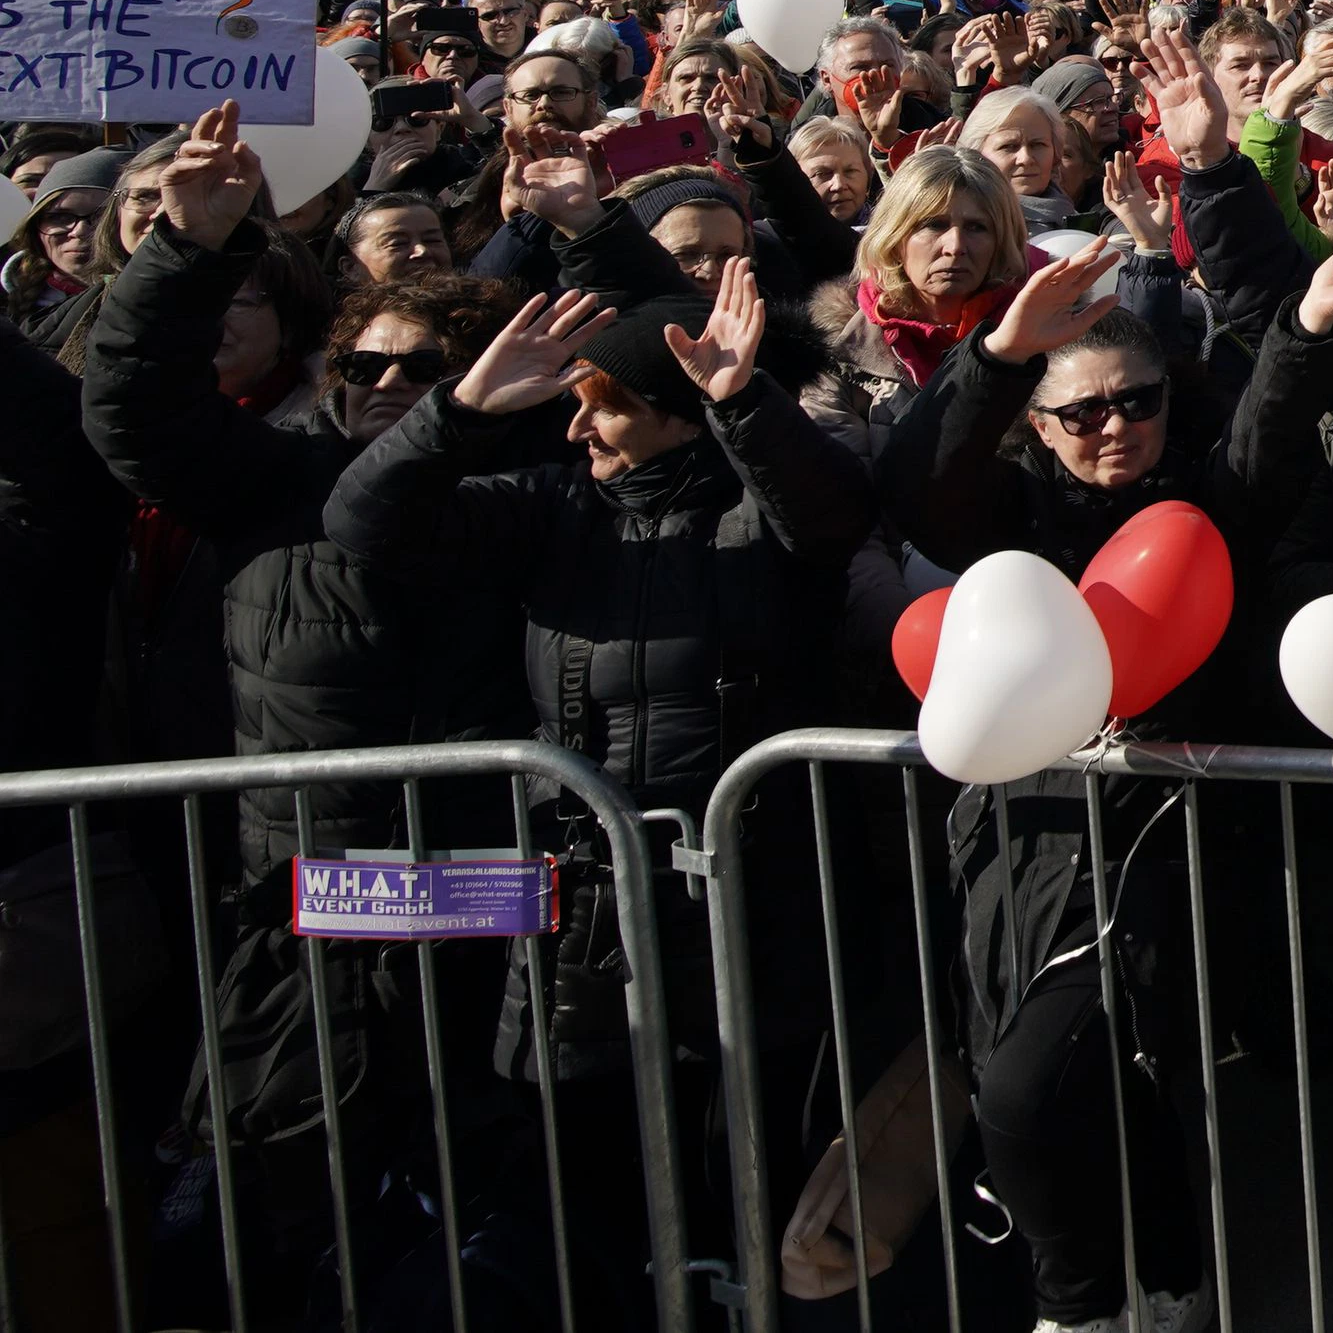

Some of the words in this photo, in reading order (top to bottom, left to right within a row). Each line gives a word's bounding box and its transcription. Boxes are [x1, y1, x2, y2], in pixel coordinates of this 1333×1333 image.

[95, 48, 296, 92] BITCOIN
[304, 868, 429, 899] W.H.A.T.
[442, 867, 536, 877] VERANSTALTUNGSTECHNIK
[302, 899, 365, 914] EVENT
[371, 899, 433, 915] GmbH
